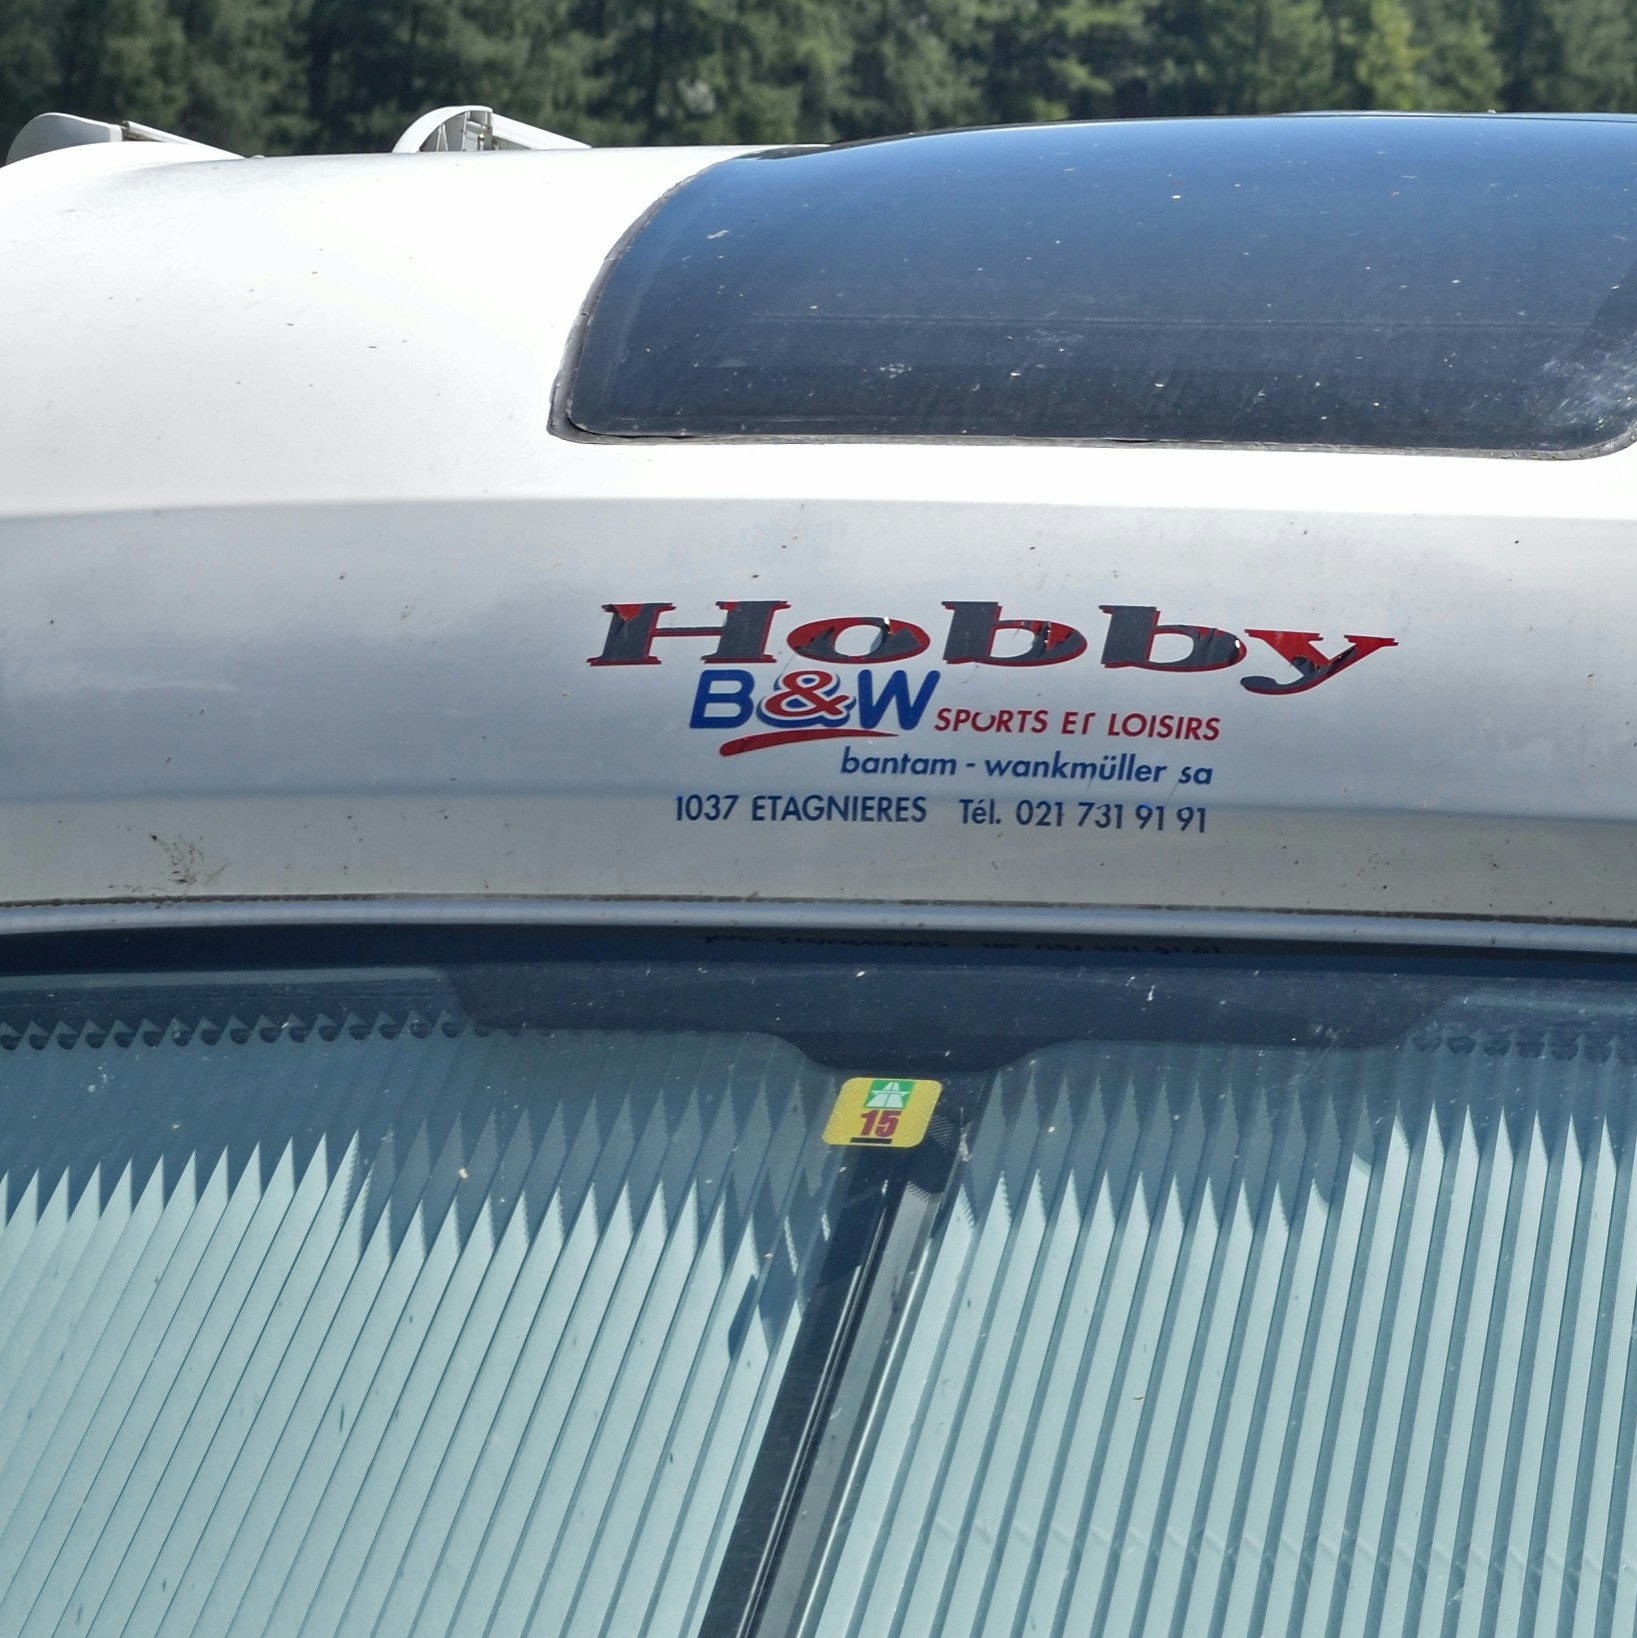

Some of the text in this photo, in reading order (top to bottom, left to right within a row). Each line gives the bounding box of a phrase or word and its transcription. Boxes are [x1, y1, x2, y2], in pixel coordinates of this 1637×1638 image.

[587, 600, 1398, 694] Hobby
[689, 669, 941, 731] B&W
[934, 707, 1048, 733] SPORTS
[1107, 713, 1220, 741] LOISIRS
[840, 746, 956, 775] bantam
[984, 750, 1168, 782] wankmüller
[1178, 766, 1213, 785] sa
[675, 793, 1206, 833] 1037 ETAGNIERES Tél. 021 731 91 91
[861, 1110, 902, 1137] 15
